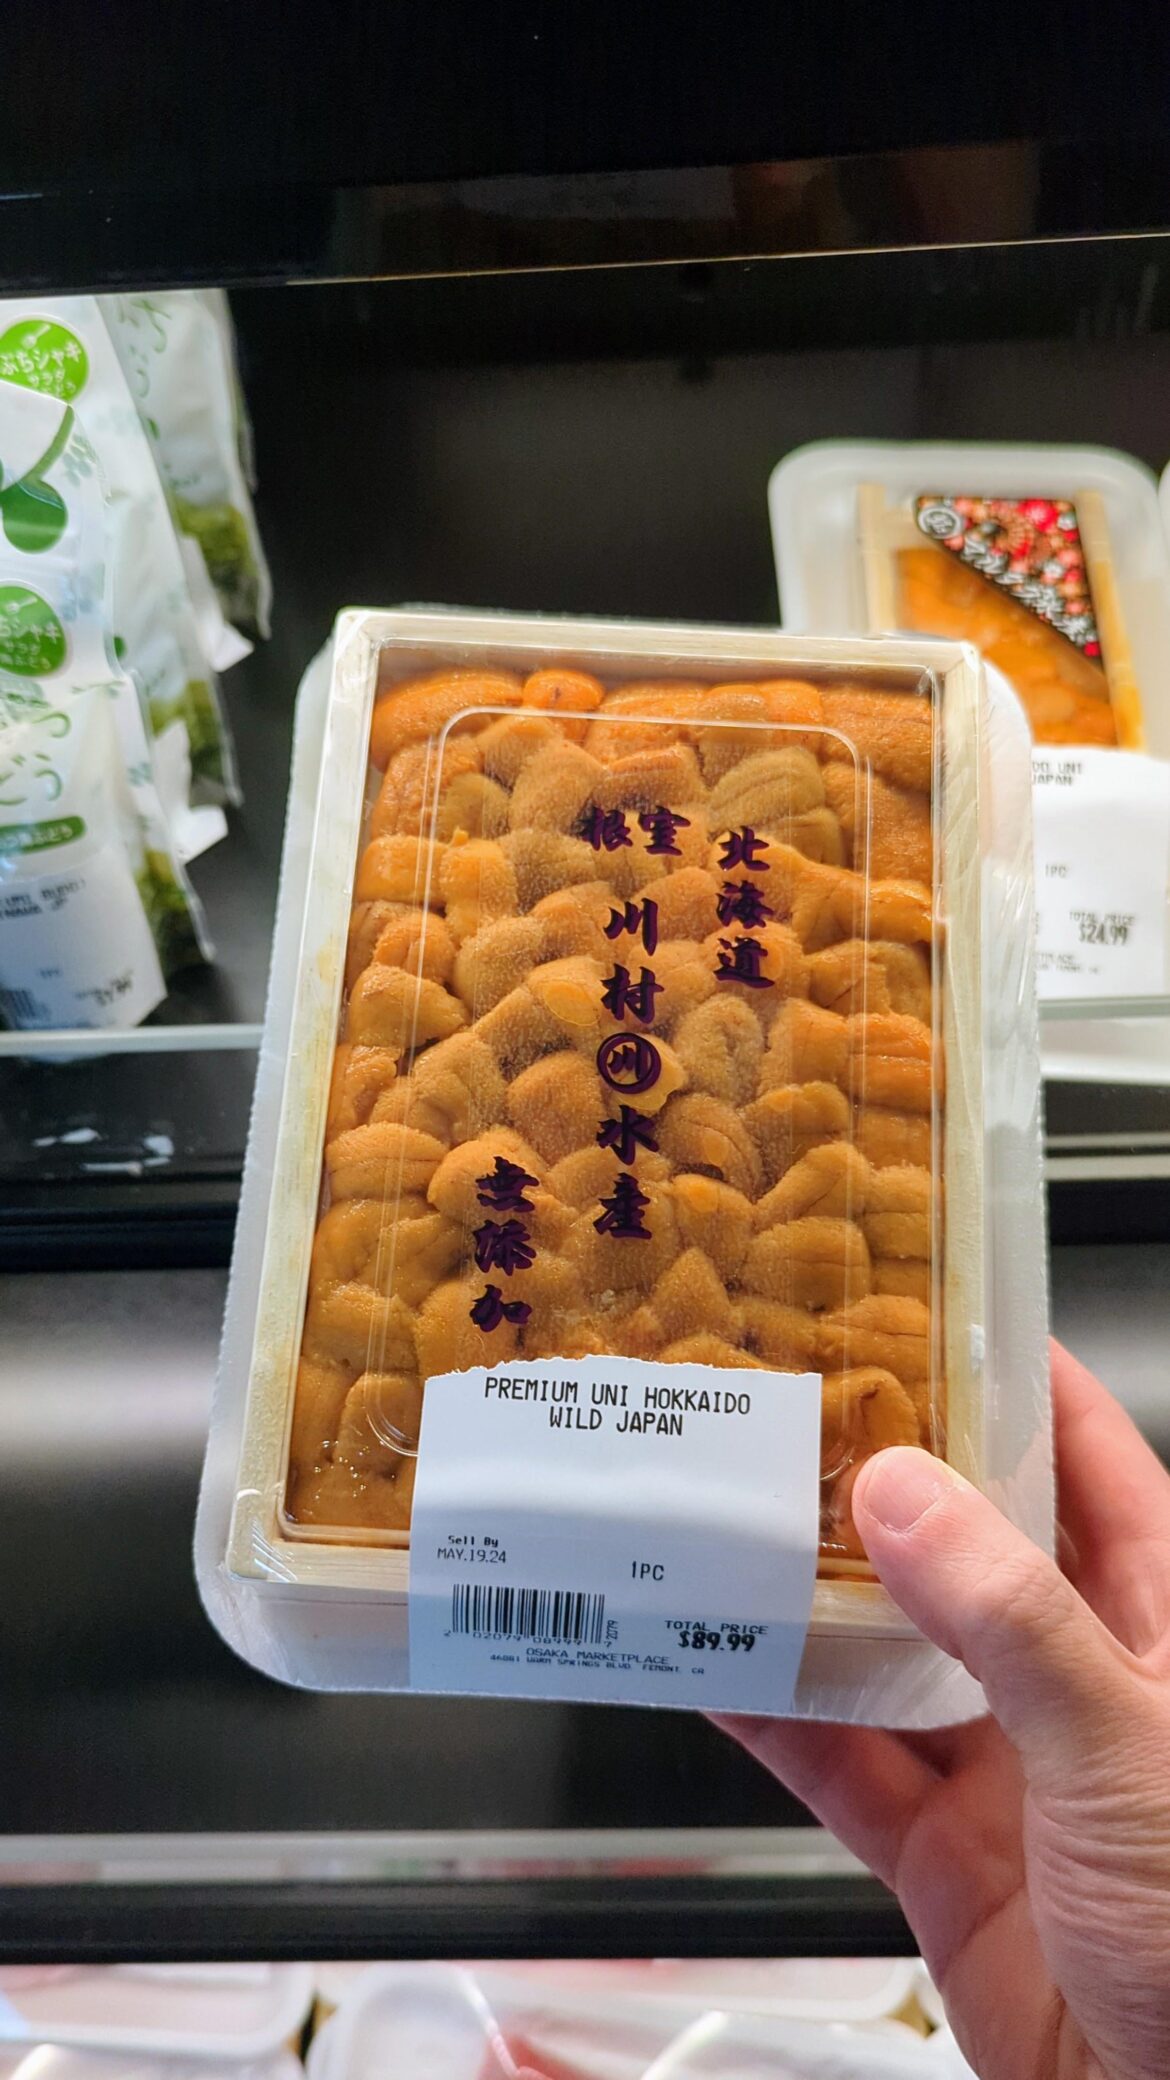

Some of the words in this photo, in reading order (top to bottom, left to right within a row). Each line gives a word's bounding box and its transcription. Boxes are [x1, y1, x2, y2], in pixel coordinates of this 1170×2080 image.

[713, 825, 776, 989] 北海道
[1079, 923, 1129, 946] $24.99
[485, 1376, 579, 1403] PREMIUM
[591, 1383, 628, 1407] UNI
[644, 1386, 751, 1415] HOKKAIDO
[550, 1406, 603, 1430] WILD
[616, 1410, 683, 1436] JAPAN
[448, 1535, 475, 1546] Sell
[484, 1536, 499, 1548] By
[437, 1547, 506, 1563] MAY.19.24
[631, 1560, 665, 1581] 1PC
[665, 1619, 711, 1632] TOTAL
[720, 1622, 769, 1635] PRICE
[678, 1630, 756, 1652] $89.99
[526, 1647, 569, 1659] OSAKA
[576, 1650, 670, 1665] MARKETPLACE
[557, 1658, 600, 1668] SPRINGS
